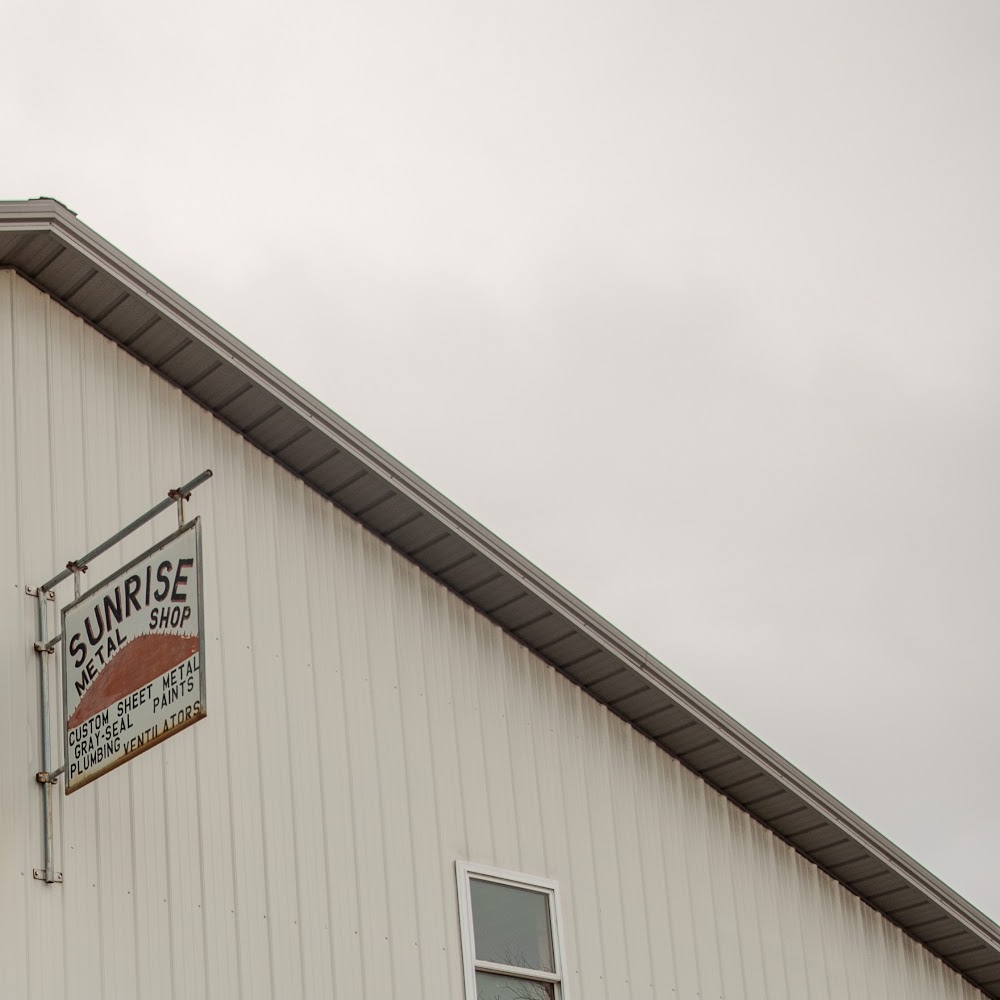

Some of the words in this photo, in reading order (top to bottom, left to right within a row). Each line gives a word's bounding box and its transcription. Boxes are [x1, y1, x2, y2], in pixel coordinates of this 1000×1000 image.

[69, 558, 194, 668] SUNRISE
[74, 628, 127, 698] METAL
[149, 606, 191, 629] SHOP
[69, 709, 109, 746] CUSTOM
[117, 684, 153, 717] SHEET
[162, 656, 200, 691] METAL
[70, 737, 121, 779] PLUMBING
[123, 700, 200, 755] VENTILATORS
[74, 715, 133, 759] GRAY-SEAL
[153, 677, 194, 714] PAINTS
